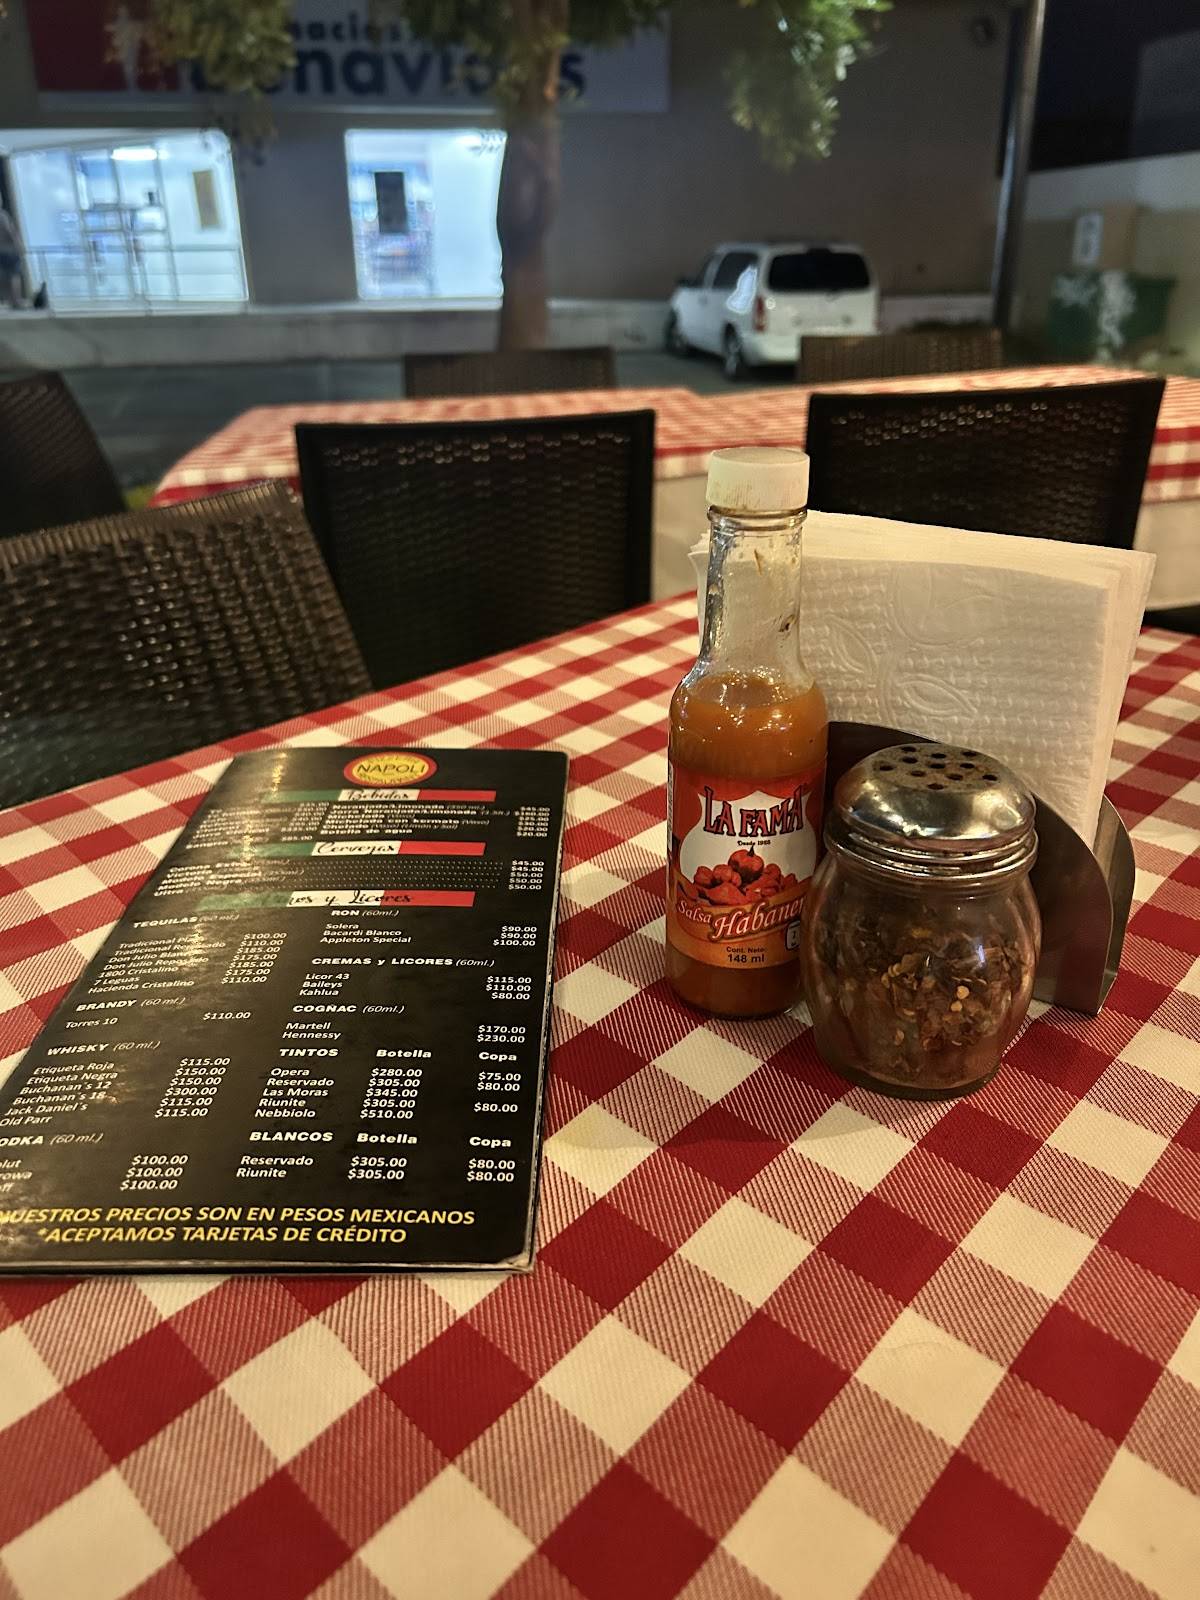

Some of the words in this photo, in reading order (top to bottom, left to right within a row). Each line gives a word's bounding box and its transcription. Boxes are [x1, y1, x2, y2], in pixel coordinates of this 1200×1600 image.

[356, 763, 426, 774] NAPOLI
[347, 788, 410, 800] Bebidas
[703, 785, 735, 836] LA
[739, 783, 805, 838] FAMA
[320, 828, 361, 836] Botella
[384, 828, 414, 836] agua
[510, 871, 544, 879] $50.00
[511, 865, 544, 873] $45.00
[508, 883, 542, 891] $50.00
[509, 877, 543, 885] $50.00
[331, 909, 360, 917] RON
[361, 909, 400, 918] (60ml.)
[678, 900, 713, 924] Salsa
[712, 899, 804, 940] Habane
[133, 916, 199, 928] TEQUILAS
[322, 929, 365, 937] Bacardi
[366, 929, 402, 937] Blanco
[501, 925, 538, 933] $90.00
[119, 937, 176, 949] Tradicional
[243, 932, 288, 940] $100.00
[319, 936, 370, 945] Appleton
[372, 936, 412, 945] Special
[500, 932, 537, 940] $90.00
[114, 945, 173, 956] Tradicional
[239, 939, 284, 947] $110.00
[492, 939, 536, 947] $100.00
[725, 945, 746, 954] Cont.
[108, 955, 127, 964] Don
[128, 952, 158, 962] Julio
[235, 946, 281, 954] $185.00
[727, 954, 748, 964] 148
[751, 953, 766, 963] ml
[103, 962, 126, 971] Don
[127, 959, 153, 969] Julio
[232, 953, 278, 961] $175.00
[311, 957, 373, 966] CREMAS
[390, 957, 454, 966] LICORES
[455, 958, 496, 968] (60ml.)
[98, 969, 127, 979] 1800
[128, 965, 179, 976] Cristalino
[228, 960, 274, 969] $185.00
[104, 976, 141, 986] Leguas
[224, 968, 271, 977] $175.00
[486, 976, 532, 984] $115.00
[88, 983, 139, 994] Hacienda
[141, 979, 195, 990] Cristalino
[220, 976, 268, 985] $110.00
[302, 980, 344, 989] Baileys
[485, 983, 532, 992] $110.00
[299, 988, 340, 997] Kahlua
[491, 991, 531, 1000] $80.00
[75, 1000, 138, 1012] BRANDY
[140, 998, 162, 1008] (60
[163, 996, 186, 1006] ml.)
[292, 1004, 358, 1014] COGNAC
[362, 1004, 406, 1015] (60ml.)
[65, 1018, 101, 1030] Torres
[102, 1017, 119, 1026] 10
[202, 1011, 251, 1021] $110.00
[285, 1022, 332, 1031] Martell
[477, 1024, 527, 1035] $170.00
[281, 1031, 342, 1041] Hennessy
[476, 1033, 526, 1043] $230.00
[47, 1043, 110, 1056] WHISKY
[113, 1041, 136, 1052] (60
[136, 1040, 162, 1050] ml.)
[278, 1048, 339, 1058] TINTOS
[376, 1049, 433, 1059] Botella
[478, 1051, 518, 1062] Copa
[33, 1063, 85, 1076] Etiqueta
[87, 1061, 116, 1072] Roja
[180, 1057, 231, 1067] $115.00
[26, 1072, 80, 1086] Etiqueta
[81, 1071, 119, 1083] Negra
[174, 1066, 227, 1077] $150.00
[270, 1067, 310, 1077] Opera
[371, 1068, 423, 1078] $280.00
[478, 1071, 522, 1082] $75.00
[19, 1081, 93, 1095] Buchanan's
[95, 1080, 113, 1090] 12
[169, 1076, 222, 1087] $150.00
[266, 1077, 335, 1087] Reservado
[368, 1077, 421, 1088] $305.00
[476, 1081, 521, 1092] $80.00
[12, 1091, 88, 1105] Buchanan's
[89, 1090, 106, 1100] 18
[164, 1086, 218, 1097] $300.00
[262, 1087, 285, 1097] Las
[287, 1087, 329, 1097] Moras
[365, 1088, 419, 1098] $345.00
[4, 1105, 34, 1117] Jack
[35, 1102, 89, 1114] Daniel's
[159, 1097, 213, 1108] $115.00
[258, 1098, 307, 1107] Riunite
[362, 1098, 416, 1109] $305.00
[473, 1102, 519, 1113] $80.00
[0, 1115, 23, 1127] Old
[23, 1114, 53, 1125] Parr
[154, 1107, 209, 1118] $115.00
[254, 1108, 316, 1118] Nebbiolo
[359, 1108, 414, 1120] $510.00
[0, 1135, 45, 1148] ODKA
[49, 1134, 75, 1146] (60
[75, 1132, 105, 1144] ml.)
[249, 1131, 334, 1142] BLANCOS
[356, 1133, 418, 1144] Botella
[468, 1136, 512, 1149] Copa
[131, 1154, 189, 1166] $100.00
[240, 1155, 314, 1166] Reservado
[350, 1156, 407, 1168] $305.00
[468, 1158, 516, 1171] $80.00
[125, 1166, 184, 1179] $100.00
[236, 1167, 287, 1179] Riunite
[347, 1168, 405, 1181] $305.00
[466, 1170, 515, 1183] $80.00
[119, 1179, 179, 1192] $100.00
[104, 1206, 193, 1222] PRECIOS
[195, 1206, 243, 1222] SON
[246, 1207, 277, 1222] EN
[280, 1207, 345, 1223] PESOS
[349, 1208, 476, 1225] MEXICANOS
[181, 1226, 278, 1242] TARJETAS
[282, 1227, 311, 1242] DE
[316, 1224, 407, 1243] CRÉDITO
